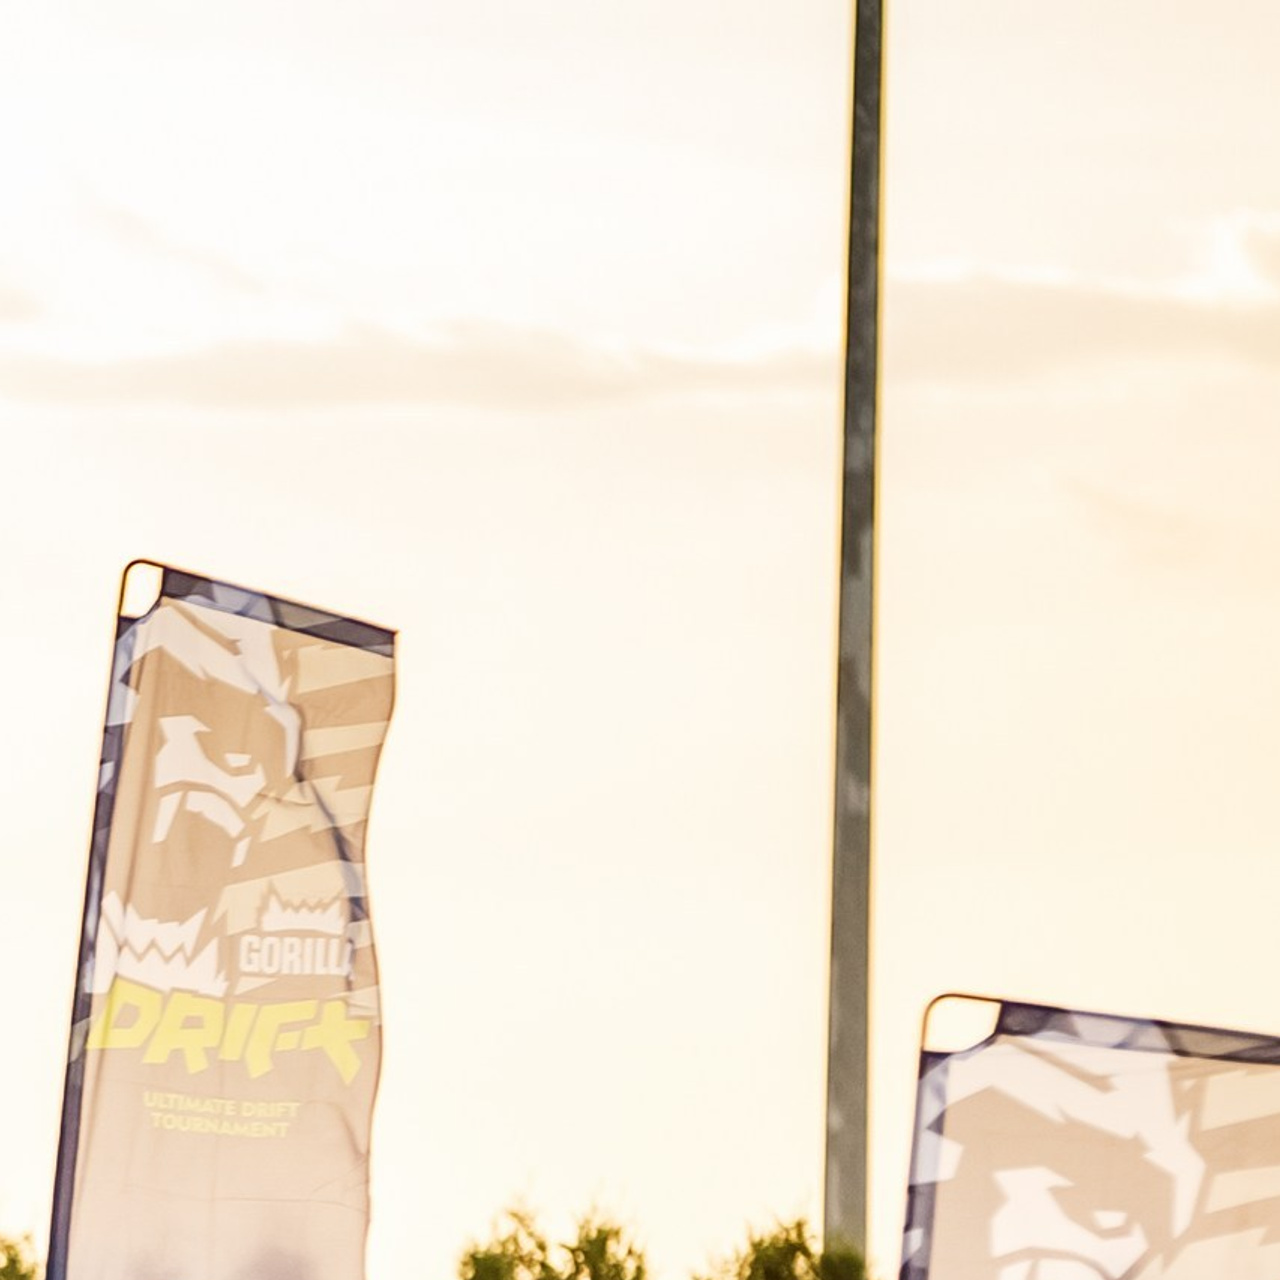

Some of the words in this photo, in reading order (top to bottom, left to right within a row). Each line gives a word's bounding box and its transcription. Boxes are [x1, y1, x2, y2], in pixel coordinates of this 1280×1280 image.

[86, 976, 371, 1087] DRIFT
[143, 1091, 237, 1116] ULTIMATE
[241, 1102, 301, 1118] DRIFT
[151, 1112, 291, 1138] TOURNAMENT
